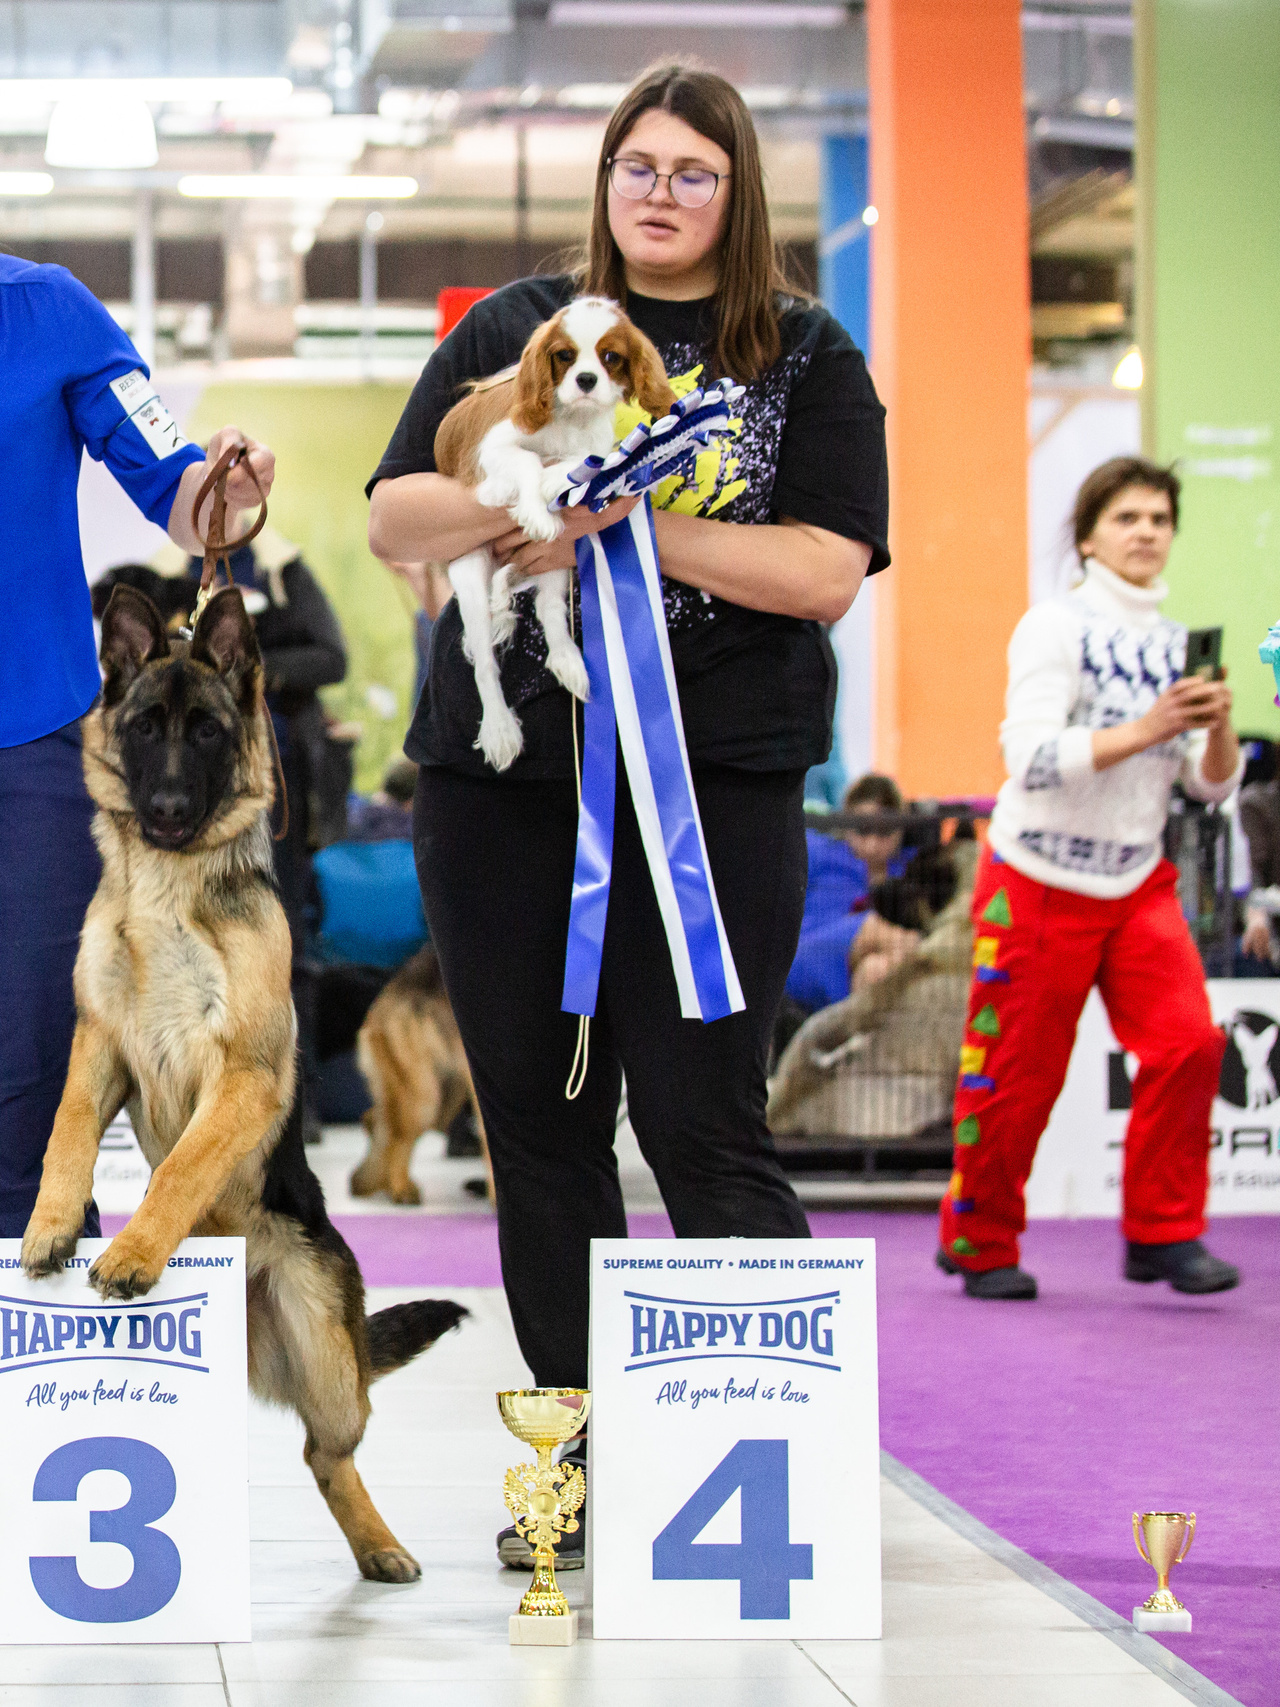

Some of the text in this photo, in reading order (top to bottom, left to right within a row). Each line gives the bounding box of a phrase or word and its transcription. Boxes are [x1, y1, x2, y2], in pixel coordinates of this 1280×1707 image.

[64, 1258, 91, 1268] LITY
[167, 1257, 234, 1267] GERMANY
[603, 1259, 864, 1270] SUPREME QUALITY MADE IN GERMANY
[0, 1307, 201, 1360] HAPPY DOG
[630, 1304, 753, 1357] HAPPY
[26, 1379, 179, 1411] All you feed is love
[655, 1377, 810, 1410] All you feed is love
[29, 1436, 181, 1623] 3
[652, 1439, 814, 1620] 4
